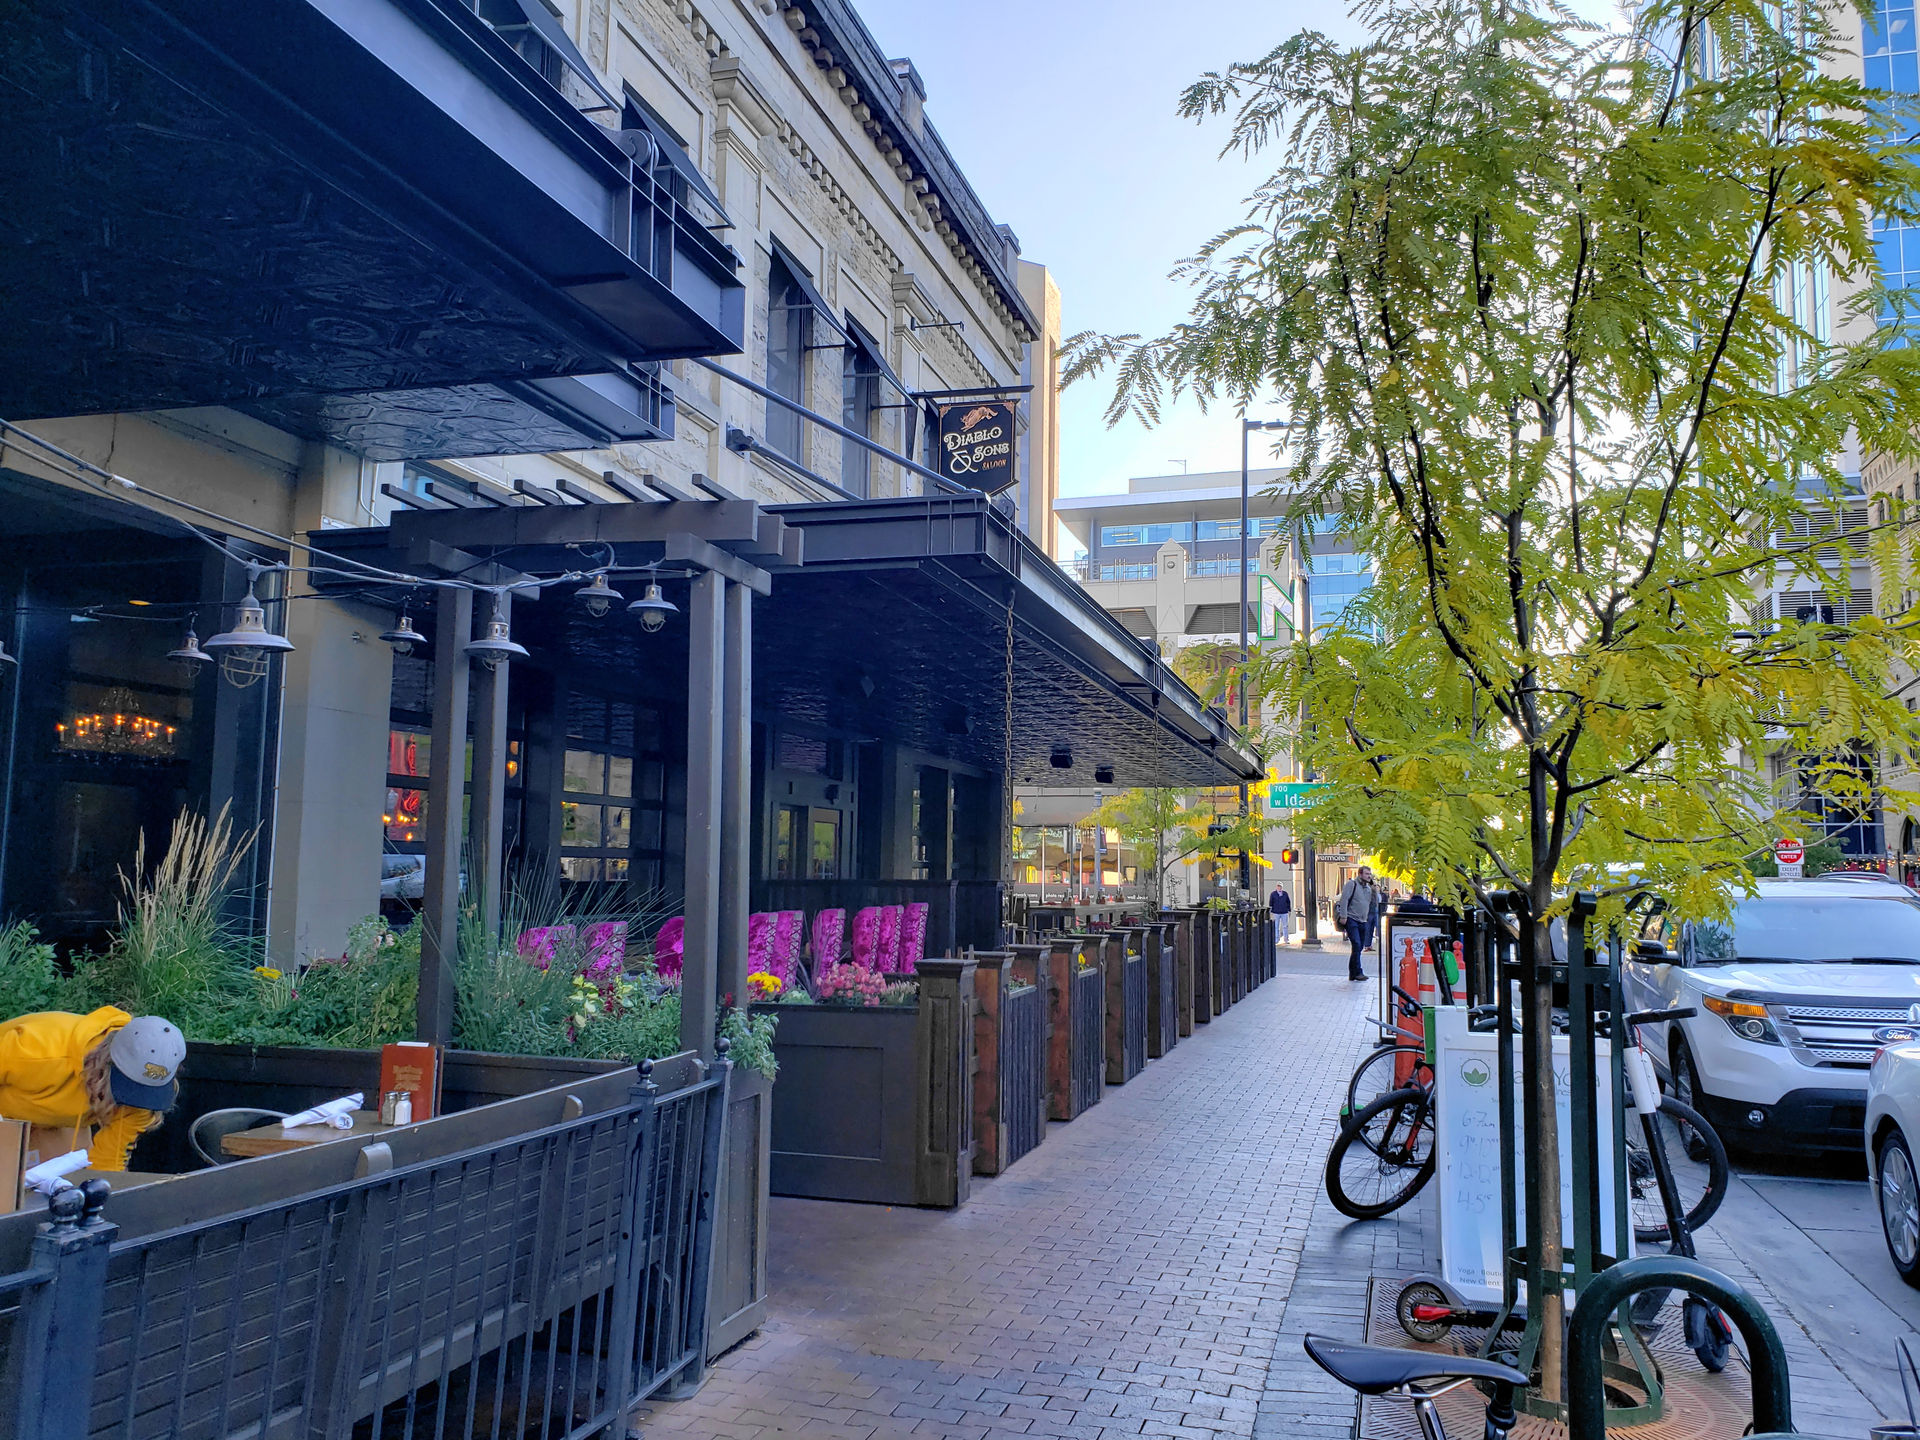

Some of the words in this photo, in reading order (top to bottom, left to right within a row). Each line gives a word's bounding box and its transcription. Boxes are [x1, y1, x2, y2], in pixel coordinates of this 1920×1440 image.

[950, 450, 978, 474] &
[973, 443, 1010, 463] SONS
[982, 459, 1007, 471] SALOON
[1886, 1029, 1912, 1040] Ford
[1457, 1267, 1475, 1275] Yoga
[1459, 1277, 1476, 1285] New
